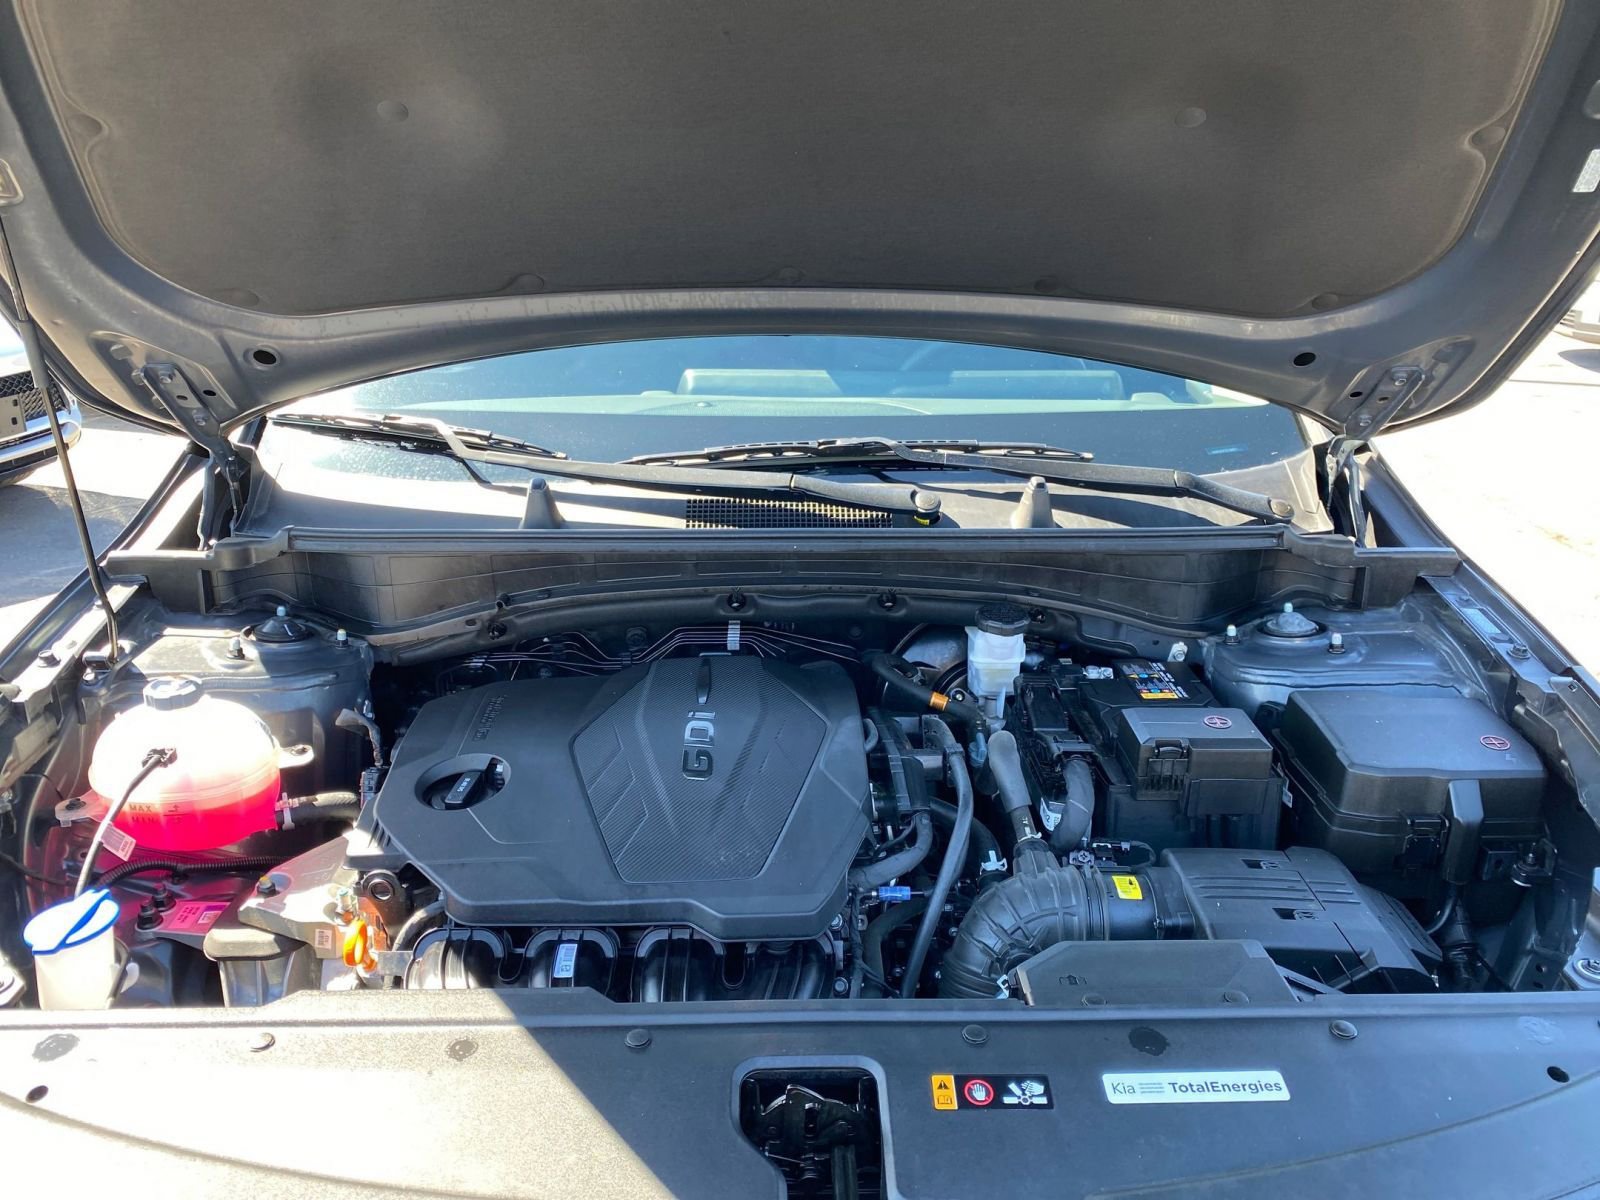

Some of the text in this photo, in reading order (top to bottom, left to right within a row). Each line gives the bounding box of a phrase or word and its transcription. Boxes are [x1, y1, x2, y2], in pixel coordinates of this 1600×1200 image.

[129, 804, 152, 813] MAX
[1111, 1080, 1283, 1095] Kia TotalEnergies
